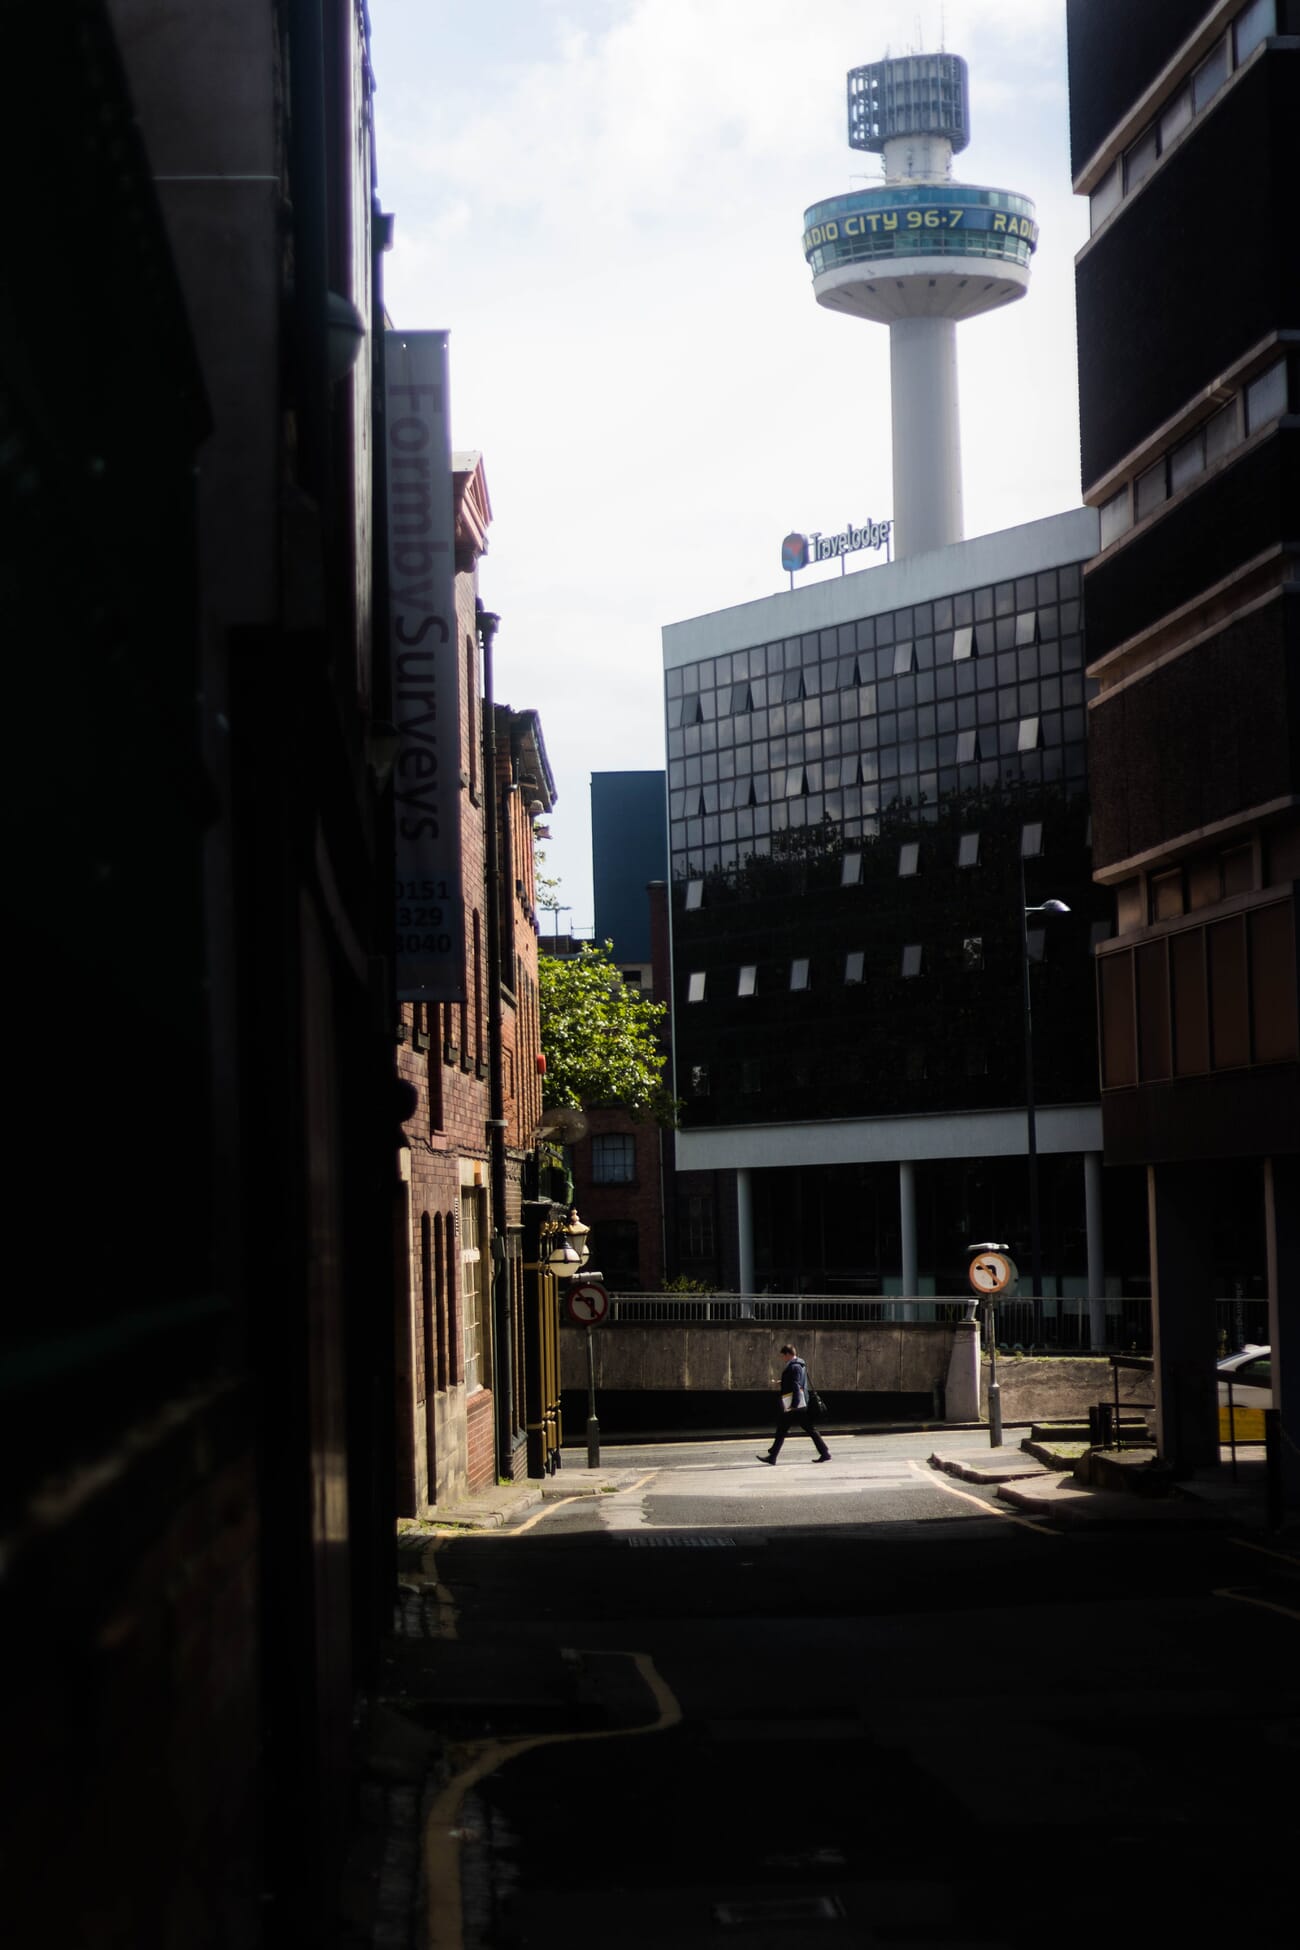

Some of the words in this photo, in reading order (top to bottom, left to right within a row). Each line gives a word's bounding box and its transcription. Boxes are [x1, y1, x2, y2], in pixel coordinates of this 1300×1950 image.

[803, 222, 838, 250] ADIO
[844, 211, 898, 236] CITY
[993, 213, 1036, 240] RADI
[809, 518, 890, 561] Travelodge
[398, 907, 443, 927] 329
